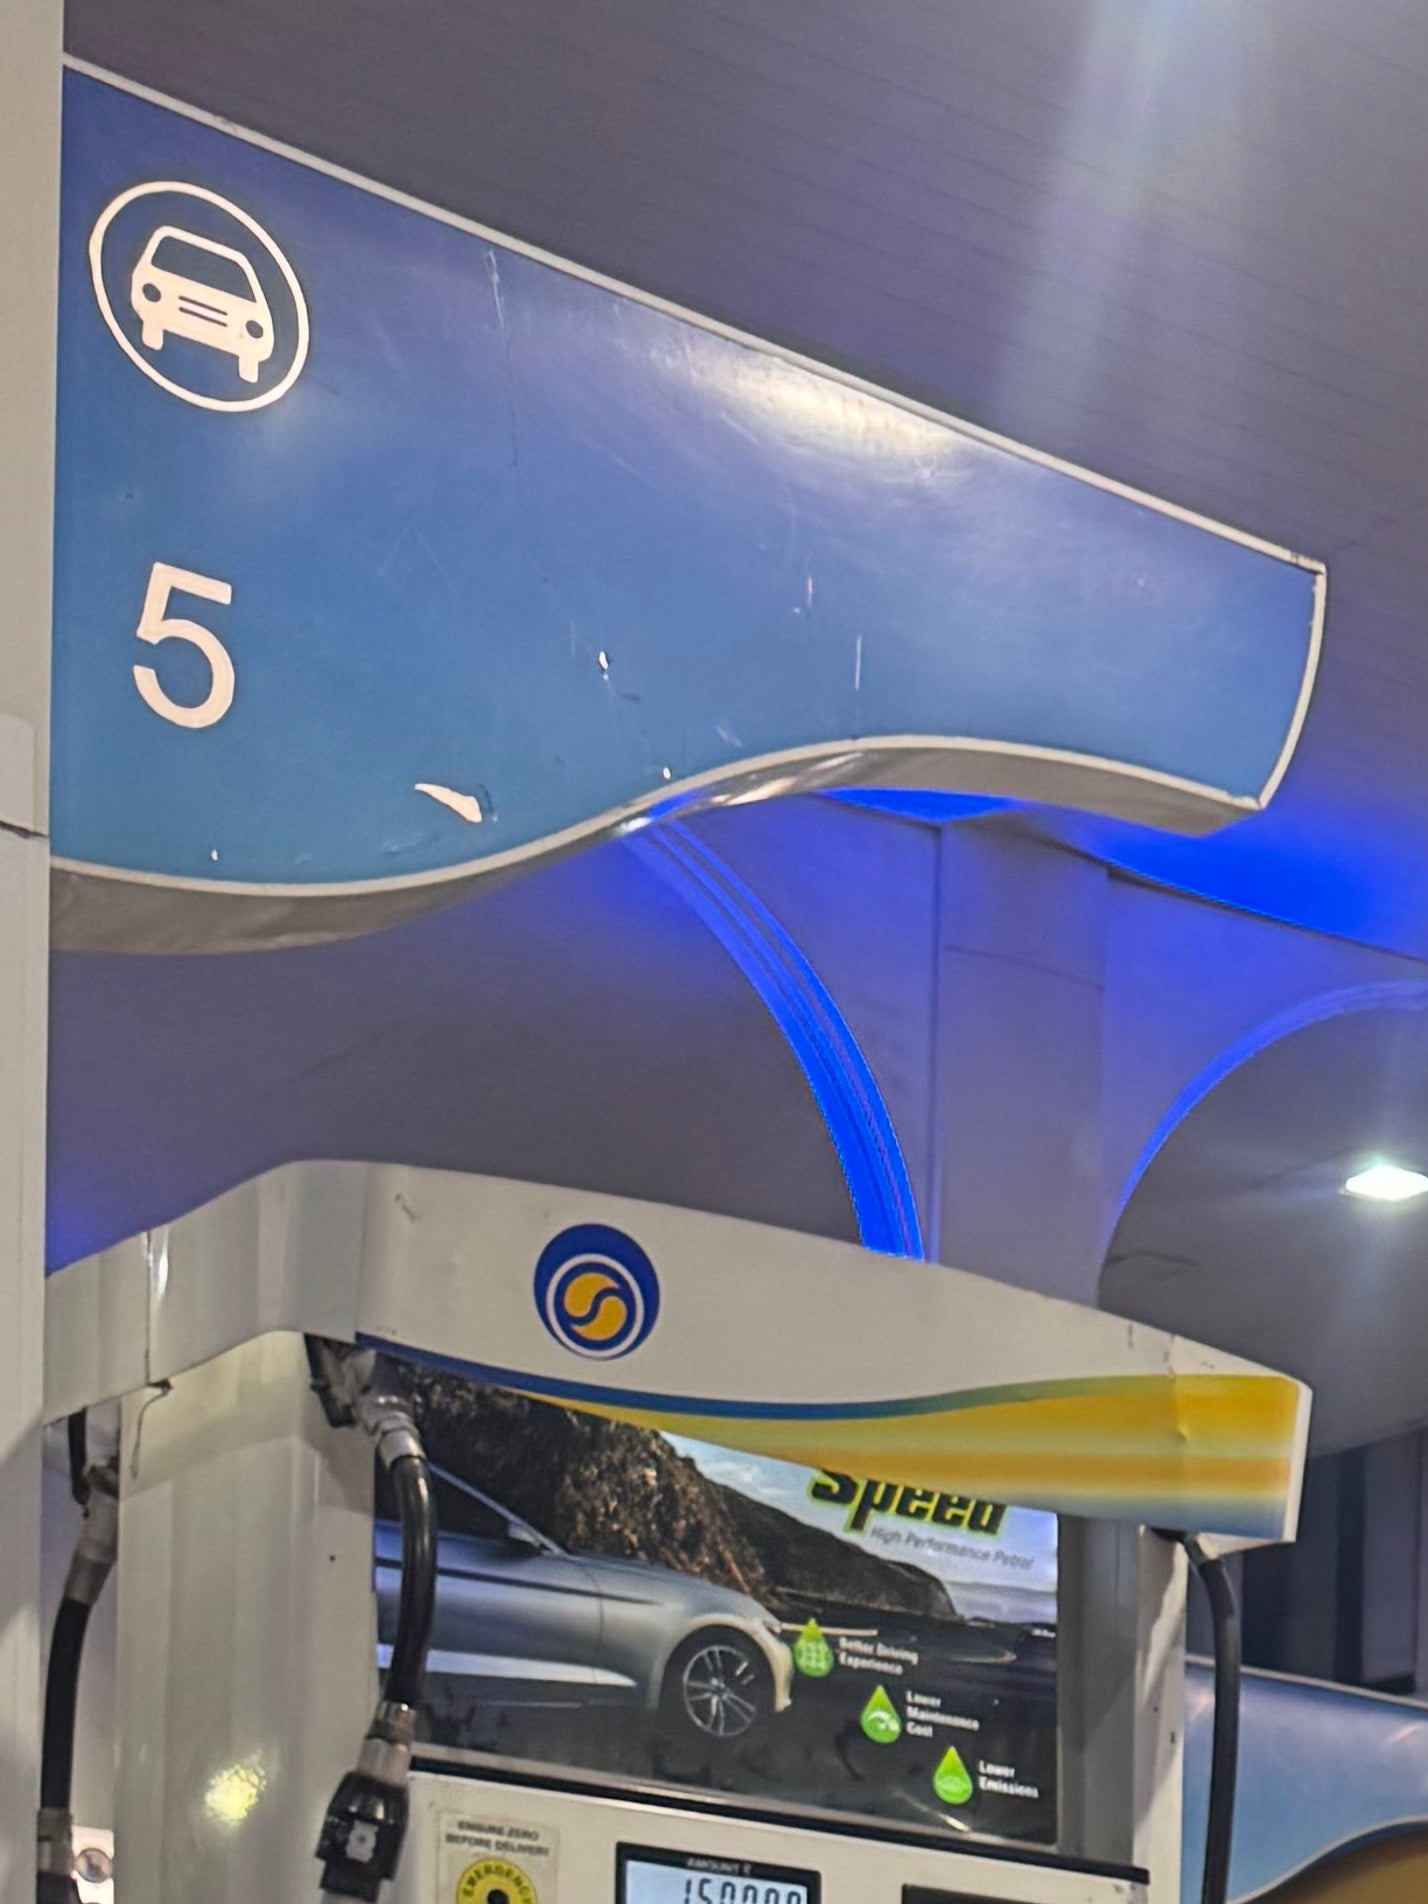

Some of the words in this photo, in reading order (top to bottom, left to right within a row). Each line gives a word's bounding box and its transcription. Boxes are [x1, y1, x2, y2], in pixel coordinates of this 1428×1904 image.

[132, 562, 236, 729] 5
[870, 1526, 901, 1546] High
[904, 1530, 991, 1561] Performance
[993, 1549, 1034, 1571] Petrol
